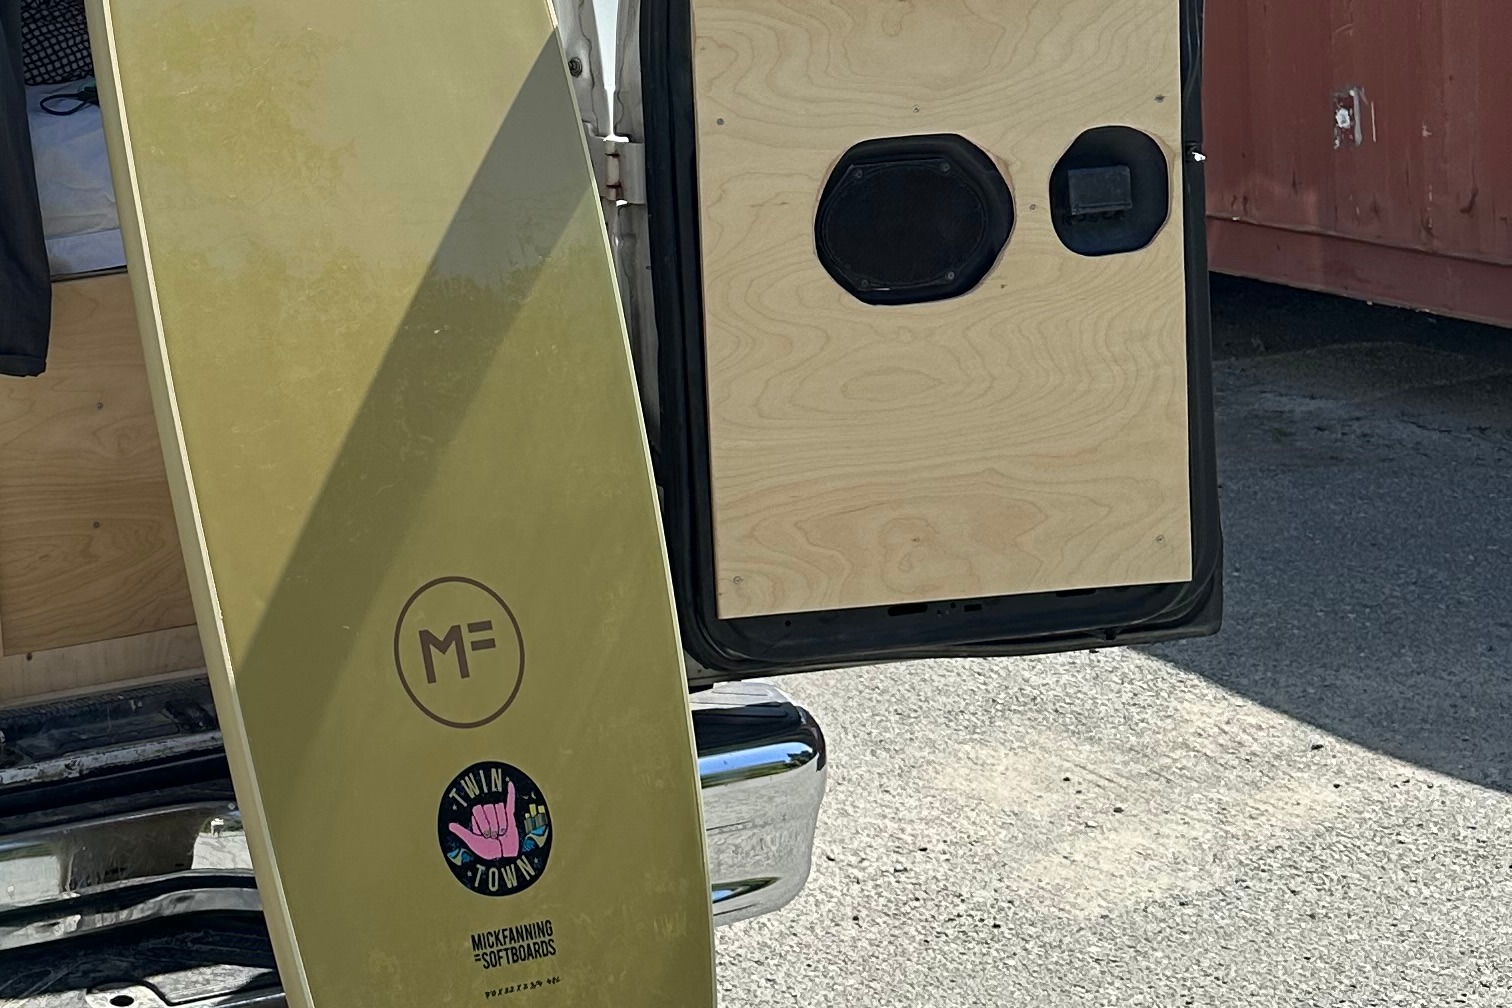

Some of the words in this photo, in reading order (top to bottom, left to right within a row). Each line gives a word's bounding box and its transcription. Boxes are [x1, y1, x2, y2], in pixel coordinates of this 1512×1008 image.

[449, 768, 502, 807] TWIN
[475, 855, 536, 891] TOWN
[471, 919, 553, 952] MICKFANNING
